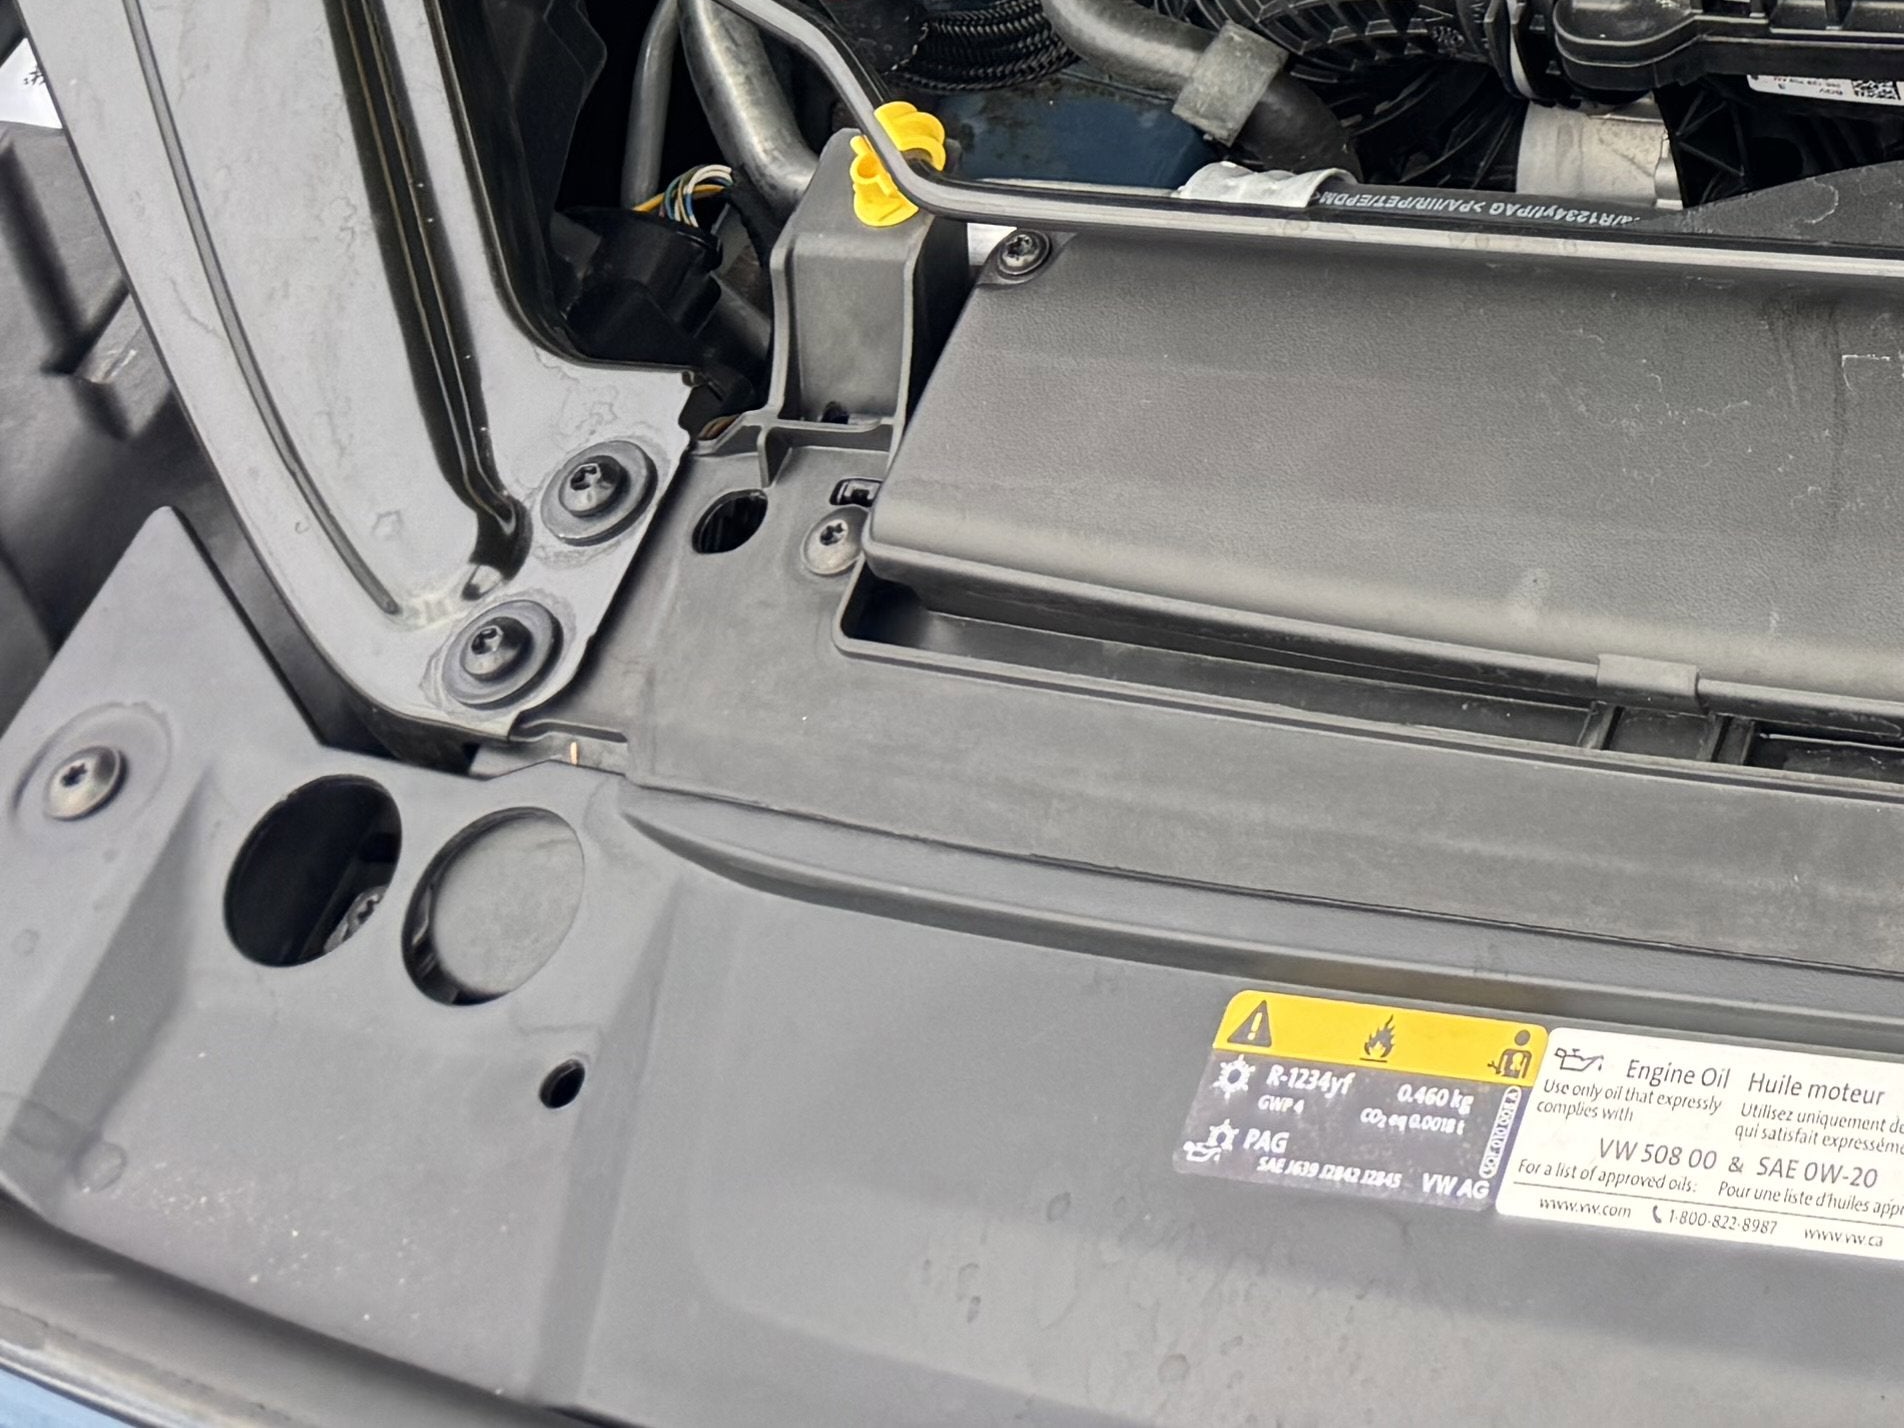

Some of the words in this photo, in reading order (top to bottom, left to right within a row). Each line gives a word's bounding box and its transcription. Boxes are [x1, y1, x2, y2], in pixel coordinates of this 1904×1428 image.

[1266, 1063, 1355, 1099] R-1234yf
[1397, 1084, 1448, 1109] 0.460
[1450, 1089, 1474, 1115] kg
[1543, 1078, 1570, 1095] Use
[1572, 1083, 1603, 1102] only
[1605, 1085, 1622, 1100] oil
[1625, 1087, 1654, 1105] that
[1657, 1093, 1723, 1116] expressly
[1626, 1058, 1696, 1088] Engine
[1701, 1067, 1731, 1090] Oil
[1748, 1071, 1803, 1098] Huile
[1807, 1082, 1886, 1106] moteur
[1258, 1095, 1293, 1112] GWP
[1293, 1099, 1304, 1114] 4
[1388, 1114, 1407, 1131] eq
[1457, 1119, 1465, 1135] t
[1536, 1099, 1598, 1121] complies
[1602, 1107, 1634, 1122] with
[1740, 1101, 1793, 1122] Utilisez
[1797, 1109, 1886, 1132] uniquement
[1243, 1129, 1290, 1154] PAG
[1734, 1122, 1760, 1139] qui
[1762, 1126, 1819, 1145] satisfait
[1257, 1156, 1284, 1175] SAE
[1599, 1138, 1638, 1161] VW
[1641, 1143, 1683, 1167] 508
[1688, 1147, 1718, 1171] 00
[1727, 1155, 1744, 1174] &
[1756, 1155, 1800, 1180] SAE
[1803, 1160, 1879, 1189] 0W-20
[1422, 1173, 1457, 1196] VW
[1459, 1179, 1490, 1199] AG
[1518, 1157, 1542, 1175] For
[1544, 1164, 1553, 1177] a
[1555, 1161, 1577, 1180] list
[1580, 1163, 1596, 1181] of
[1598, 1166, 1666, 1190] approved
[1668, 1176, 1698, 1194] oils:
[1718, 1180, 1751, 1200] Pour
[1753, 1187, 1781, 1202] une
[1784, 1188, 1814, 1207] liste
[1815, 1192, 1870, 1214] d'huiles
[1539, 1197, 1632, 1219] www.vw.com
[1668, 1208, 1778, 1235] 1-800-822-8987
[1804, 1227, 1884, 1248] www.vw.ca
